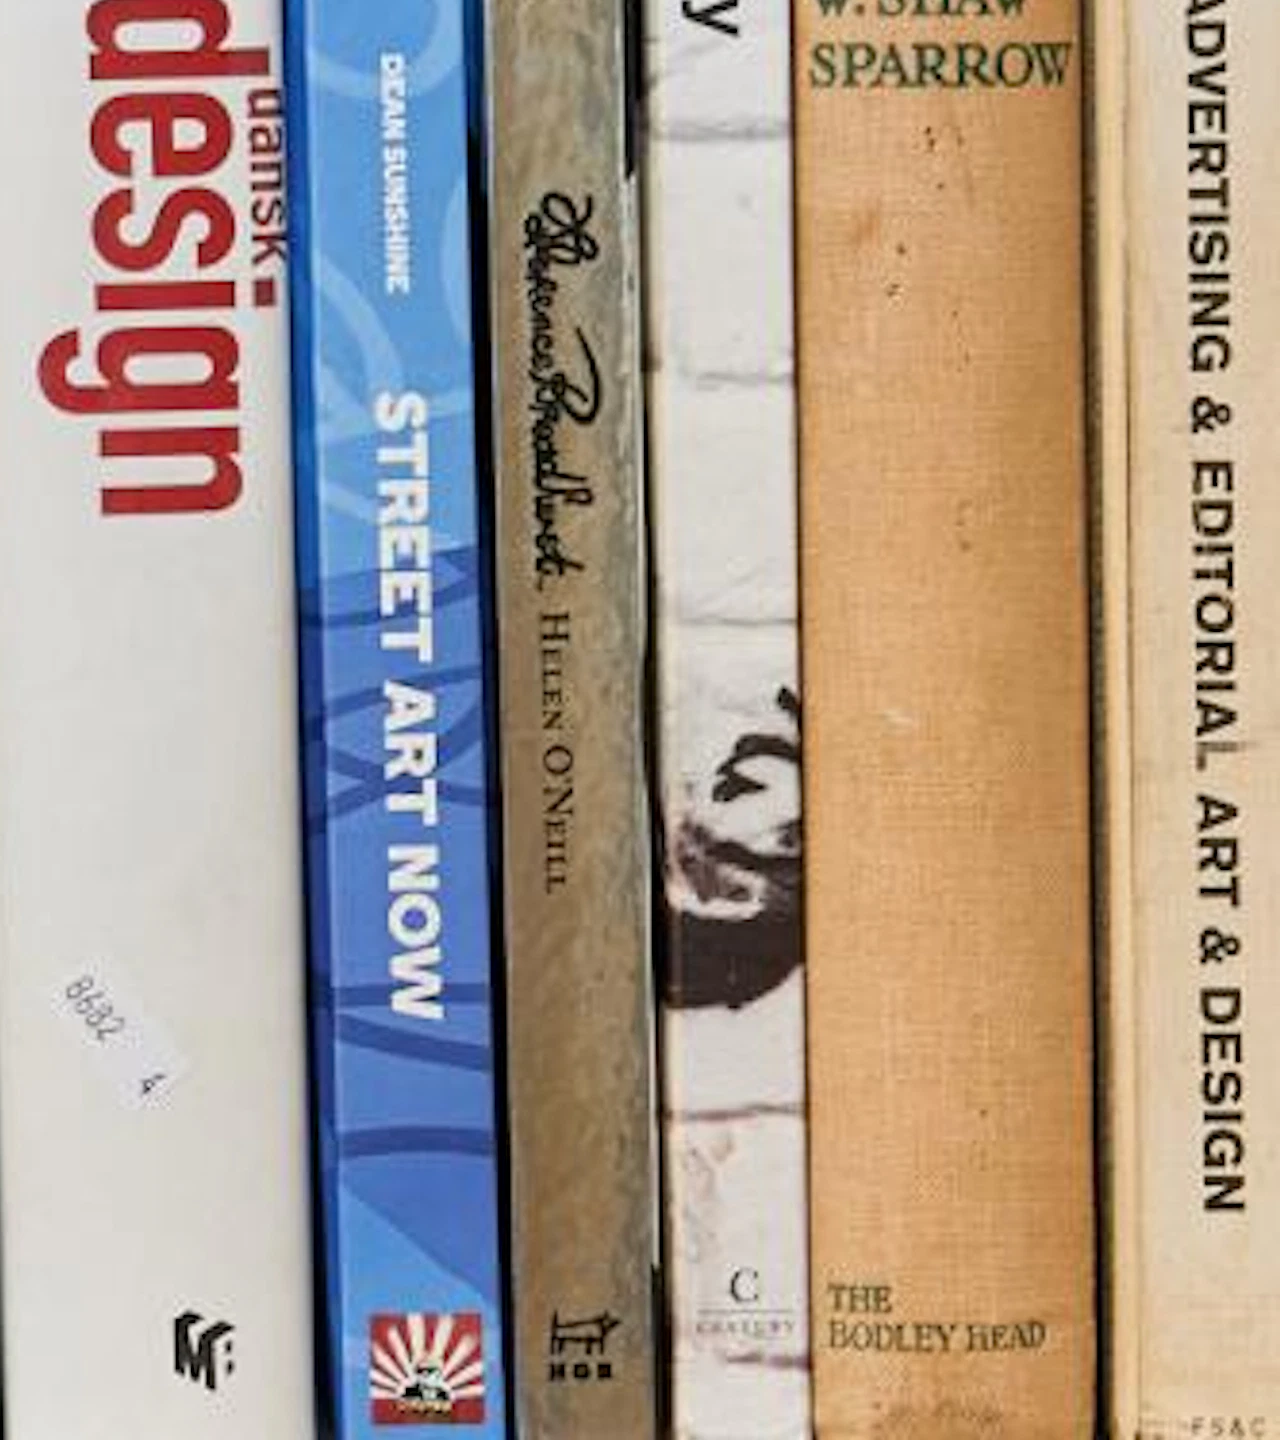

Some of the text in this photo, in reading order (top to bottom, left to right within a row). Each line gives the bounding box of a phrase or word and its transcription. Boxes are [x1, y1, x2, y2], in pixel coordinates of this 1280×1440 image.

[810, 42, 1072, 89] SPARROW
[378, 52, 410, 294] DEAN SUNSHINE
[1191, 396, 1232, 434] &
[1191, 460, 1238, 771] EDITORIAL
[374, 391, 446, 1020] STREET ART NOW
[1196, 793, 1241, 906] ART
[1197, 926, 1241, 965] &
[1197, 987, 1246, 1214] DESIGN
[731, 1268, 758, 1302] C
[827, 1285, 892, 1314] THE
[828, 1320, 1046, 1353] BODLEY HEAD
